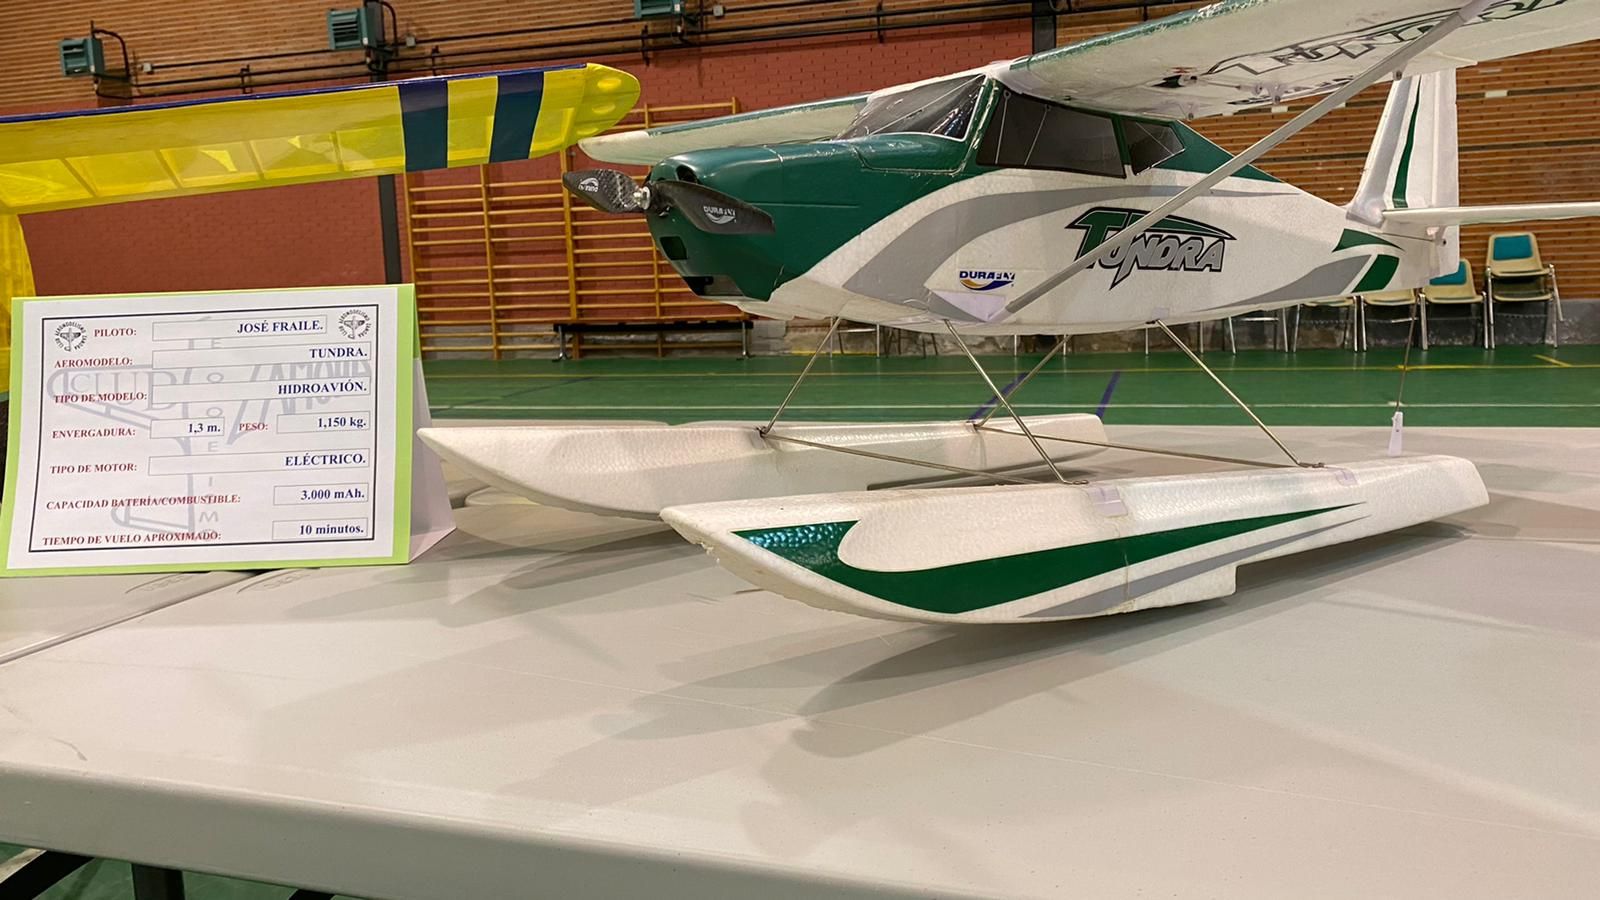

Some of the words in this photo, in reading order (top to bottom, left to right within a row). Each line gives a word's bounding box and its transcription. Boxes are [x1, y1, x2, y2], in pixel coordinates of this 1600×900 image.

[959, 270, 1015, 280] DURAFLY
[94, 328, 137, 337] PILOTO:
[237, 320, 269, 334] JOSÉ
[272, 320, 324, 332] FRAILE.
[309, 347, 368, 359] TUNDRA.
[54, 357, 133, 369] AEROMODELO:
[278, 379, 368, 395] HIDROAVIÓN.
[54, 394, 79, 404] TIPO
[81, 394, 96, 402] DE
[98, 392, 148, 402] MODELO:
[188, 423, 204, 433] 1,3
[207, 425, 221, 433] m.
[239, 422, 269, 431] PESO:
[318, 417, 347, 428] 1,150
[350, 417, 367, 428] kg.
[52, 428, 136, 439] ENVERGADURA:
[285, 453, 366, 467] ELÉCTRICO.
[50, 465, 75, 474] TIPO
[77, 464, 92, 473] DE
[94, 463, 137, 472] MOTOR:
[301, 490, 331, 501] 3.000
[334, 488, 365, 499] mAh.
[46, 499, 109, 510] CAPACIDAD
[300, 525, 313, 535] 10
[316, 524, 364, 535] minutos.
[43, 535, 85, 546] TIEMPO
[87, 535, 102, 544] DE
[105, 533, 141, 543] VUELO
[144, 531, 222, 543] APROXIMADO:
